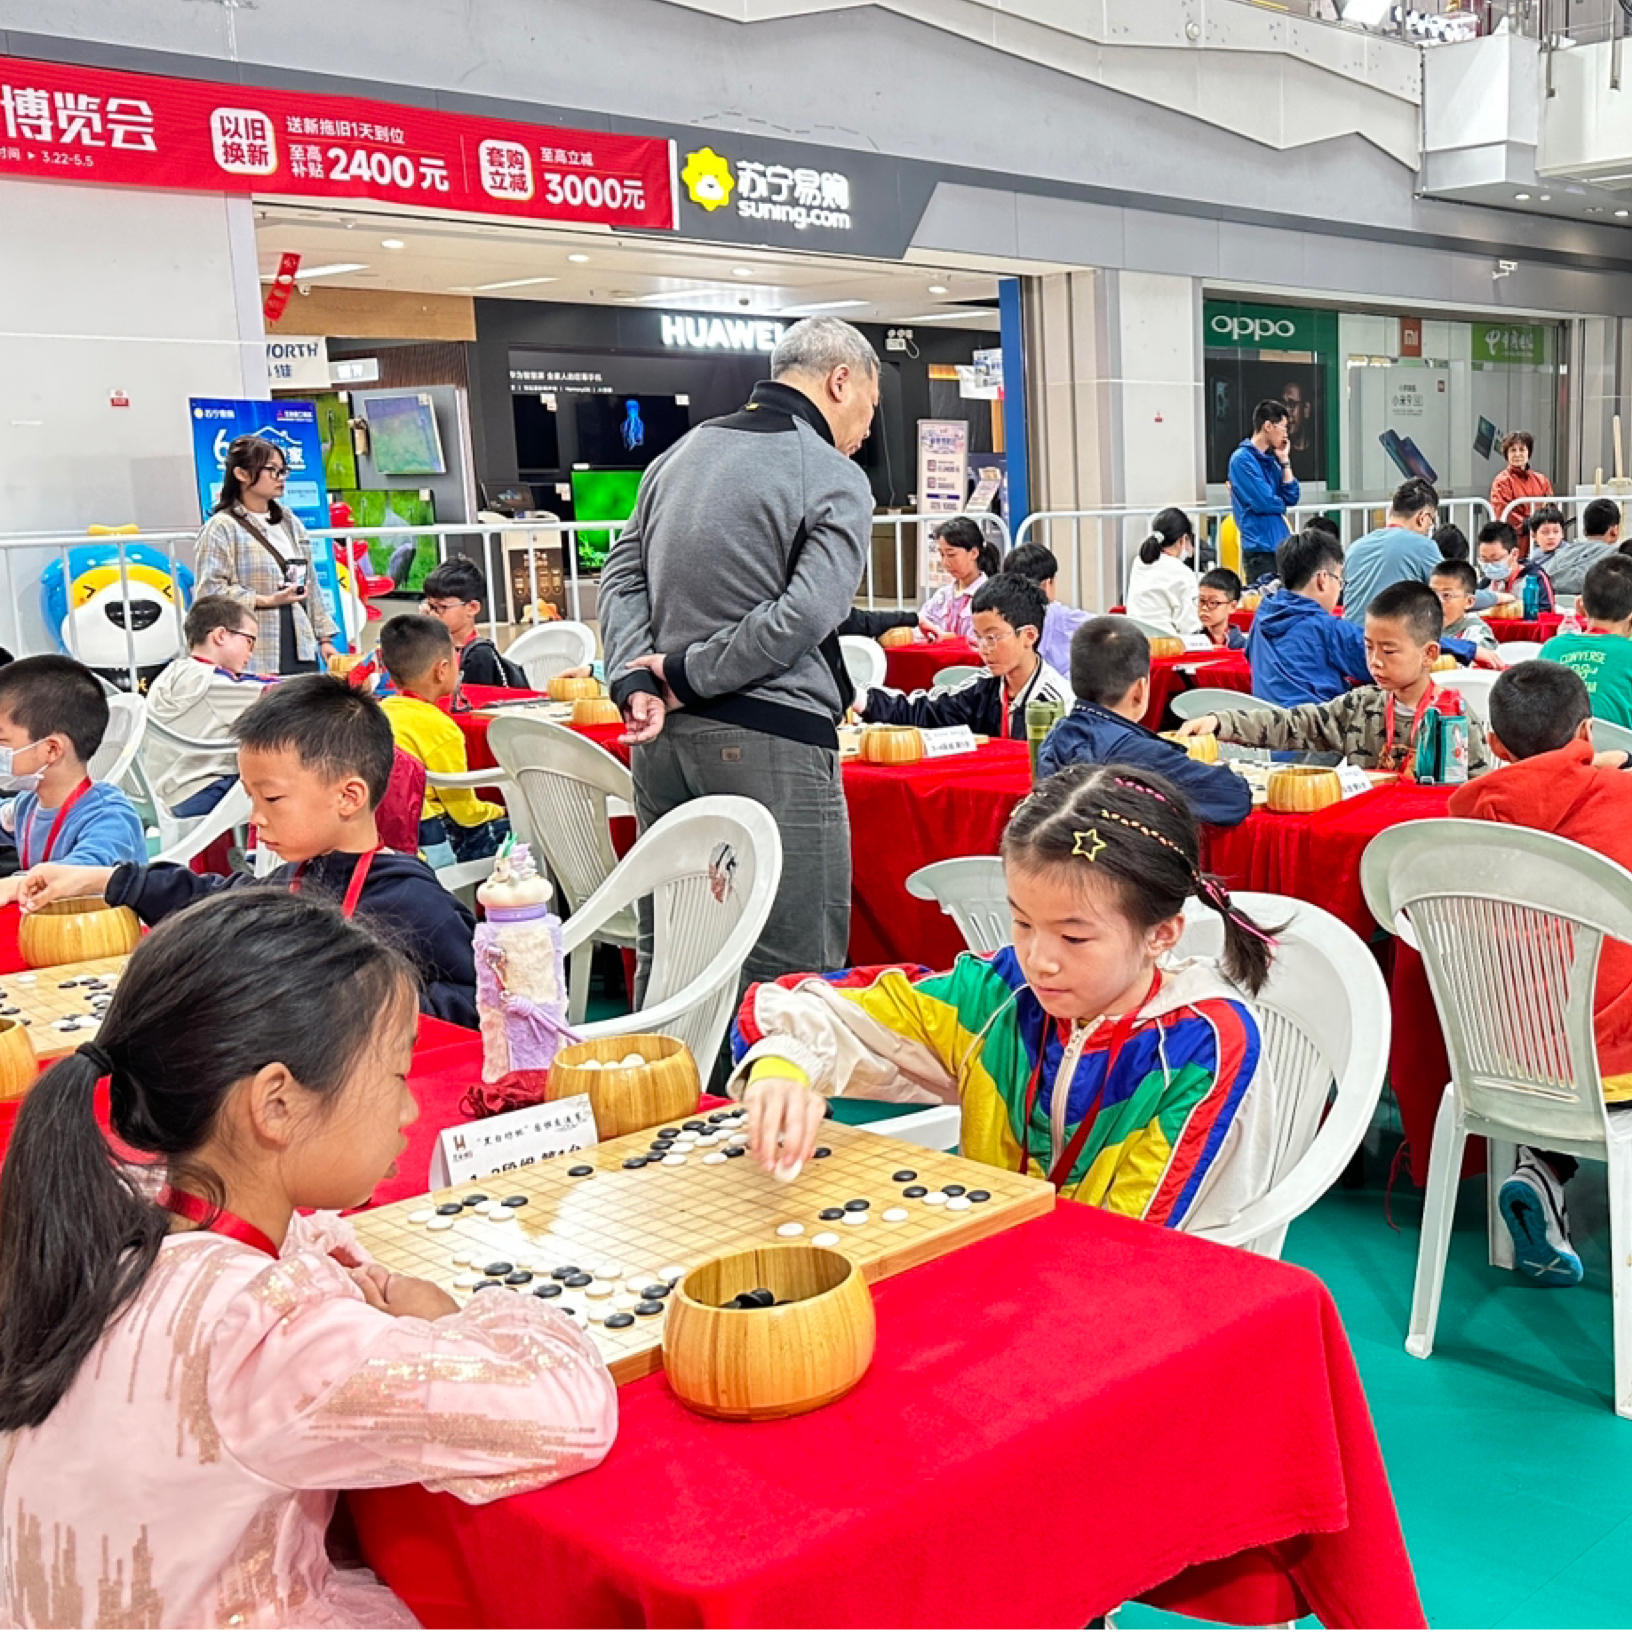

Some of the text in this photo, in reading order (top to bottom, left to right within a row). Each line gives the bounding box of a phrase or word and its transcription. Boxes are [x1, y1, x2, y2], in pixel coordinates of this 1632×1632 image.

[1, 83, 158, 152] 博览会
[219, 114, 266, 142] 以旧
[285, 115, 405, 144] 送新拖旧1天到位
[41, 150, 94, 167] 3.22-5.5
[221, 140, 270, 167] 换新
[288, 143, 322, 163] 至高
[539, 146, 595, 167] 至高立减
[291, 160, 325, 179] 补贴
[489, 169, 529, 194] 立减
[543, 171, 646, 211] 3000元
[735, 159, 850, 210] 苏宁易购
[737, 200, 852, 230] suning.com
